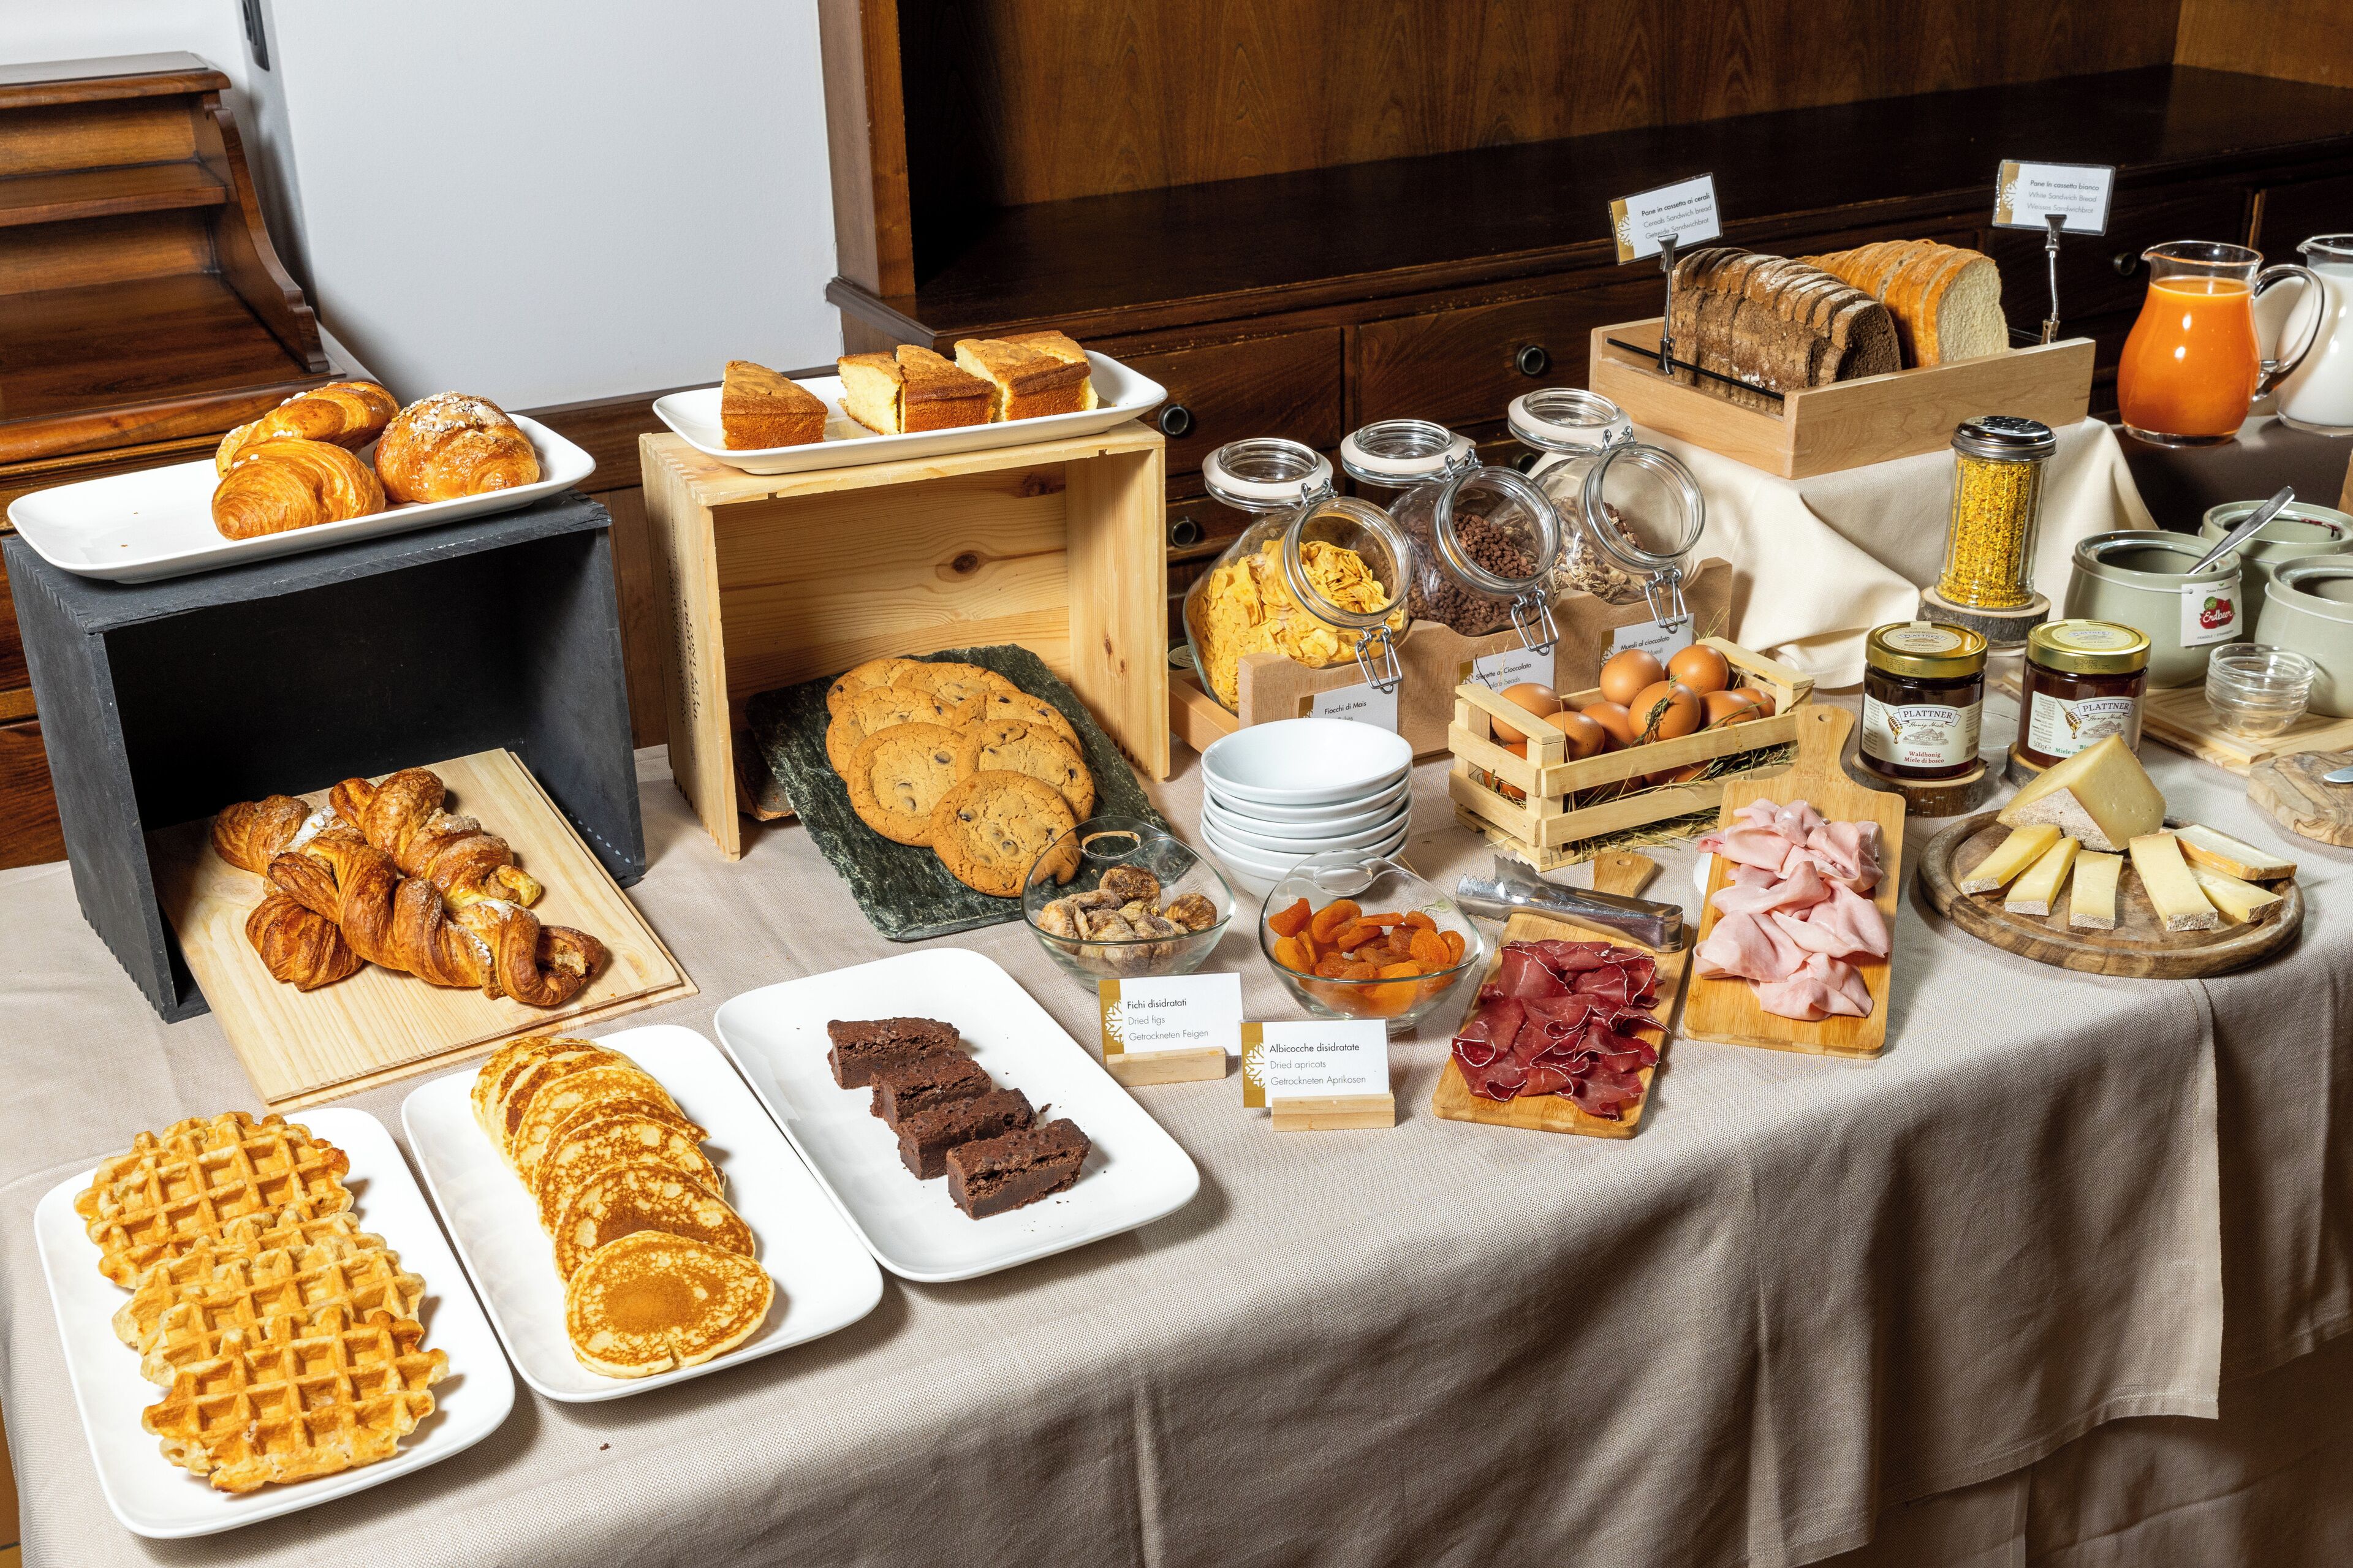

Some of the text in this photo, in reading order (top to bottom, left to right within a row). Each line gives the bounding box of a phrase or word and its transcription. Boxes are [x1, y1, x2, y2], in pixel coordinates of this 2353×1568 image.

[1664, 201, 1686, 210] cassetta
[1694, 192, 1710, 203] cerali
[2053, 205, 2093, 213] Sandwichbrot
[1643, 204, 1712, 228] Cereals Sandwich bread
[1672, 218, 1709, 233] Sandwichbrot
[2203, 609, 2234, 623] Erdbeer
[1621, 642, 1637, 650] Muesli
[1645, 636, 1670, 645] cioccolato
[1504, 663, 1531, 673] Cioccolato
[1324, 705, 1344, 714] Fiocchi
[2083, 703, 2129, 712] PLATTNER
[1903, 710, 1953, 719] PLATTNER
[1127, 998, 1187, 1009] Fichi disidratati
[1128, 1015, 1165, 1026] Dried figs
[1129, 1029, 1208, 1041] Getrockneten Feigen
[1270, 1042, 1360, 1053] Albicocche disidratate
[1270, 1060, 1326, 1070] Dried apricots
[1270, 1075, 1366, 1086] Getrockneten Aprikosen
